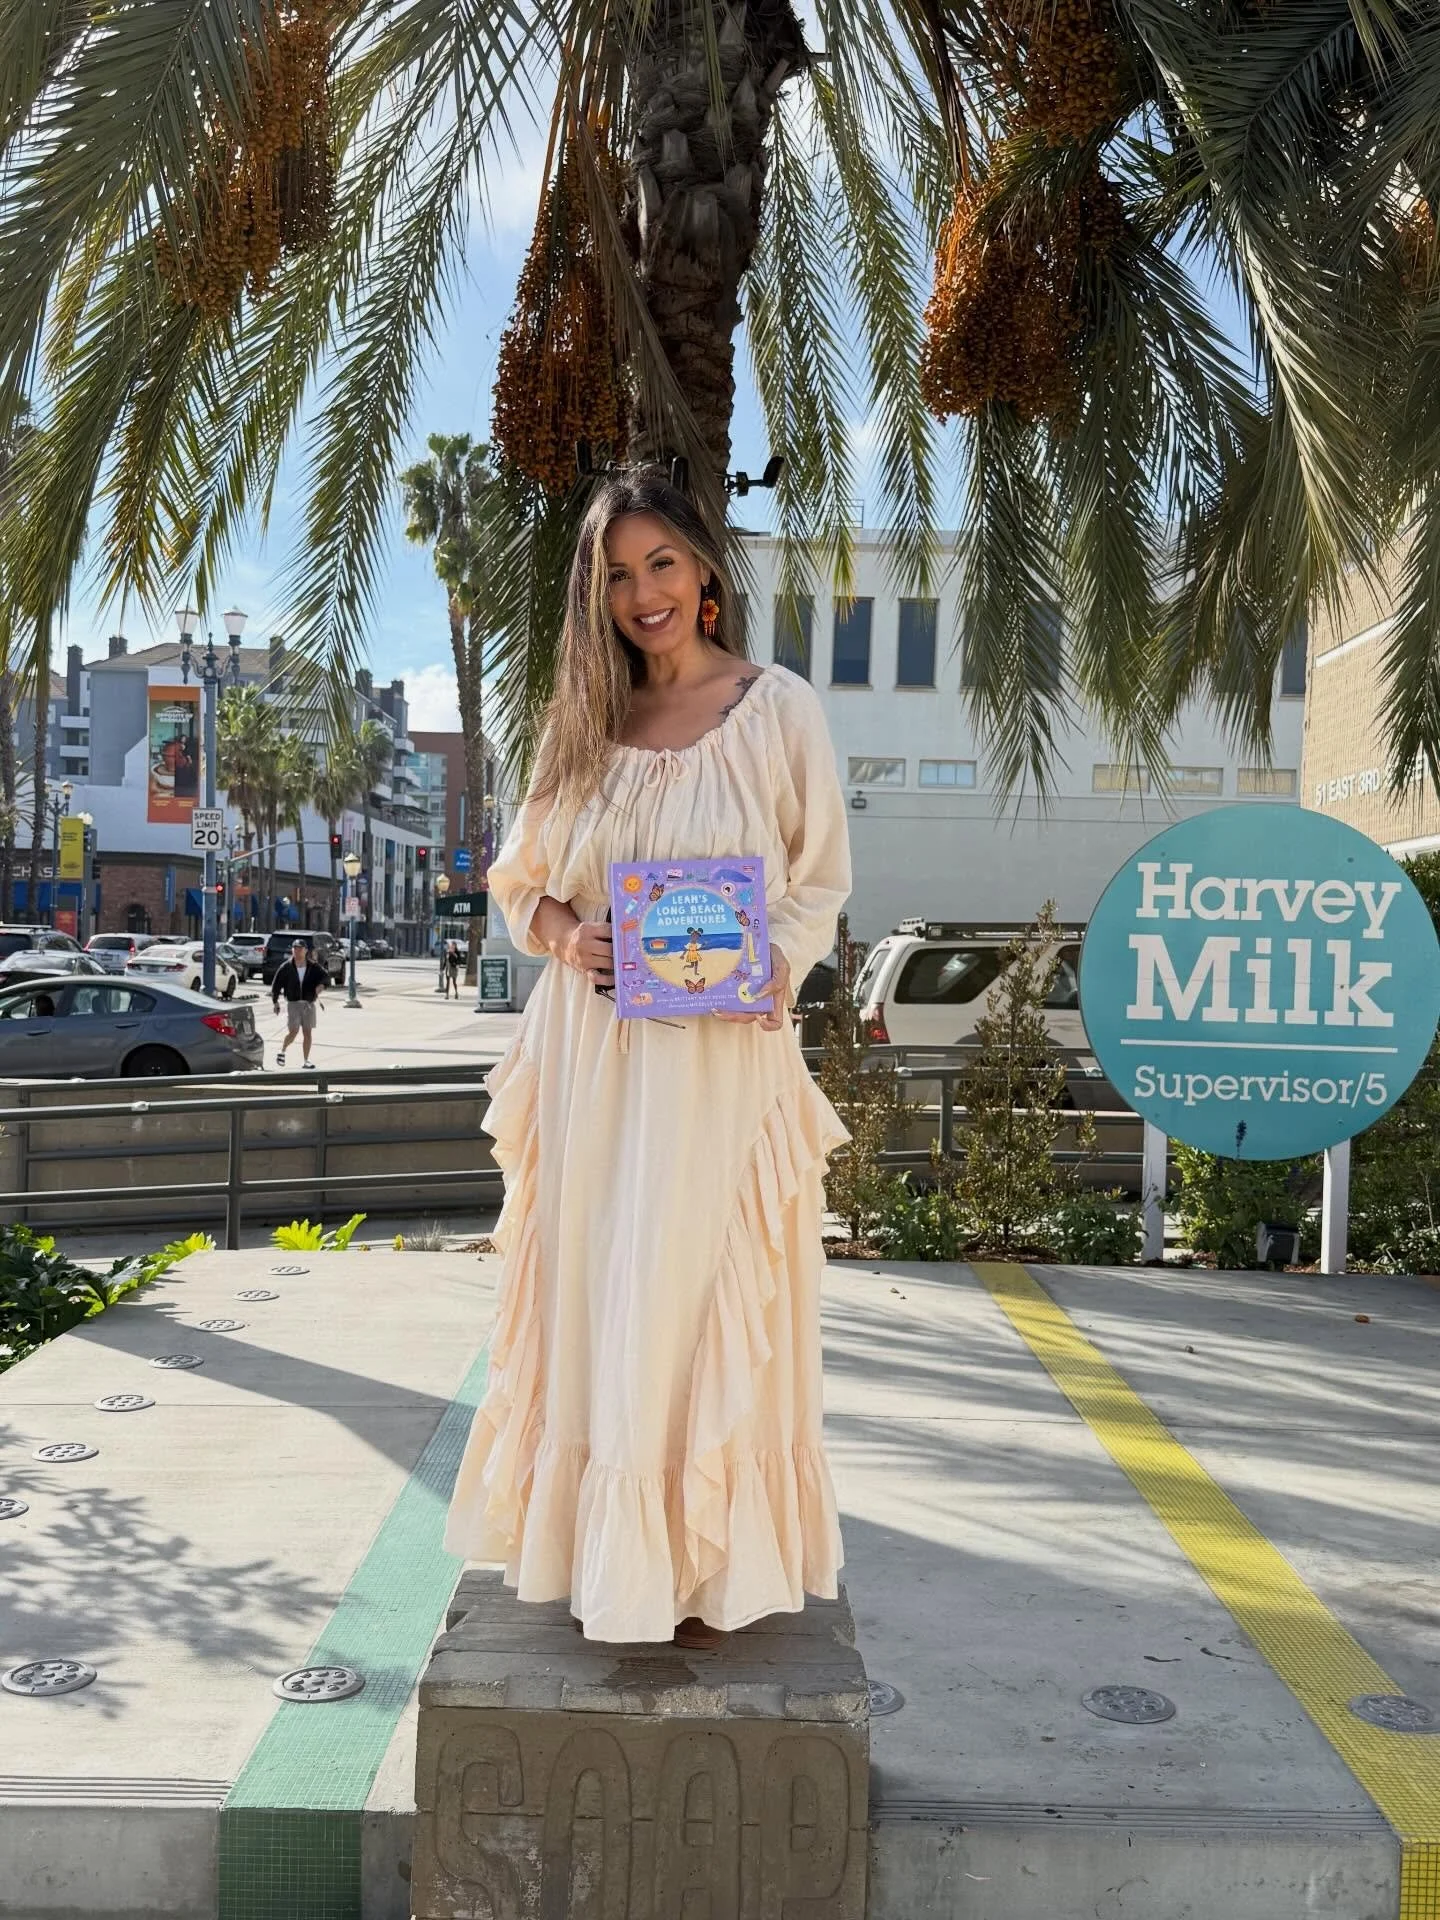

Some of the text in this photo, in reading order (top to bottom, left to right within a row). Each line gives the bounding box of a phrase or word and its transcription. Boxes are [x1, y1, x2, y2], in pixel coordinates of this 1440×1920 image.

[1328, 774, 1355, 803] EAST
[1358, 768, 1380, 795] 3RD
[194, 812, 220, 820] SPEED
[194, 830, 219, 845] 20
[672, 894, 708, 905] LEAH'S
[1136, 862, 1402, 939] Harvey
[453, 902, 471, 914] ATM
[657, 904, 725, 916] LONG BEACH
[657, 914, 726, 926] ADVENTURES
[1126, 934, 1394, 1027] Milk
[1134, 1065, 1388, 1108] Supervisor/5
